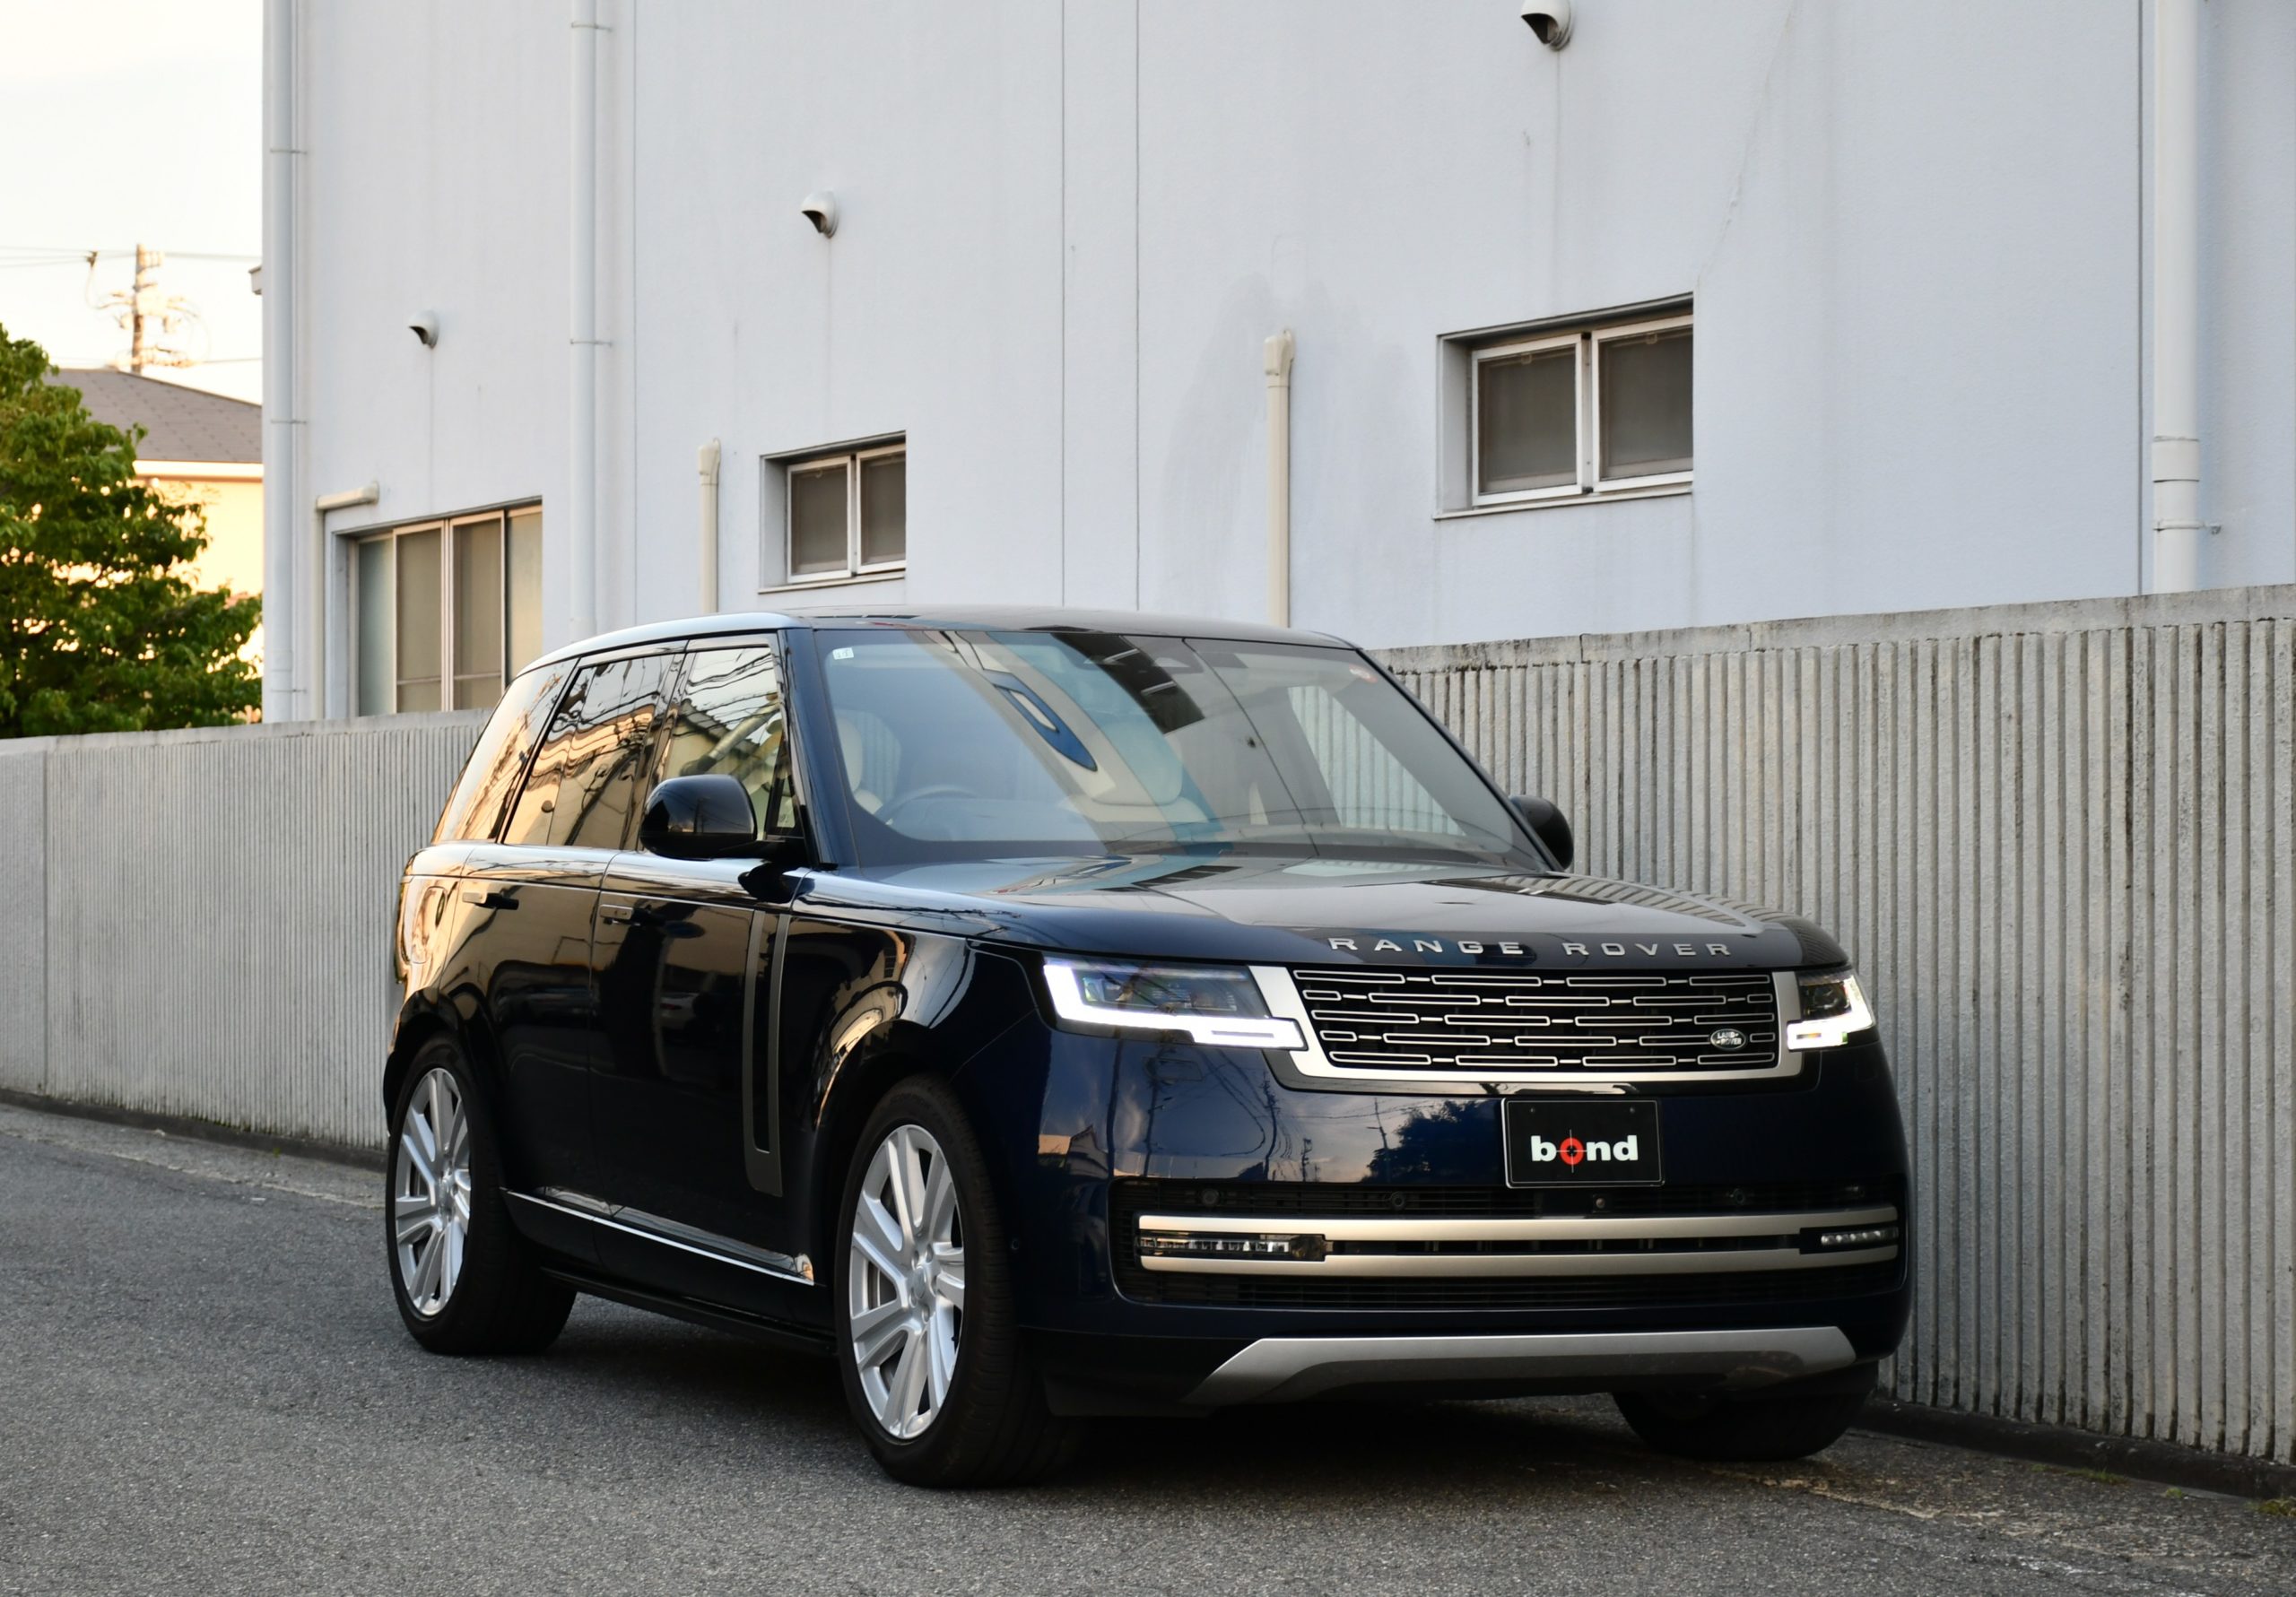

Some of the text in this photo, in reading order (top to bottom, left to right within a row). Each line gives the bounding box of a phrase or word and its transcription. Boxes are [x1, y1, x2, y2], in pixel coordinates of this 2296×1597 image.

[1327, 937, 1731, 956] RANGE ROVER
[1531, 1134, 1639, 1165] bond
